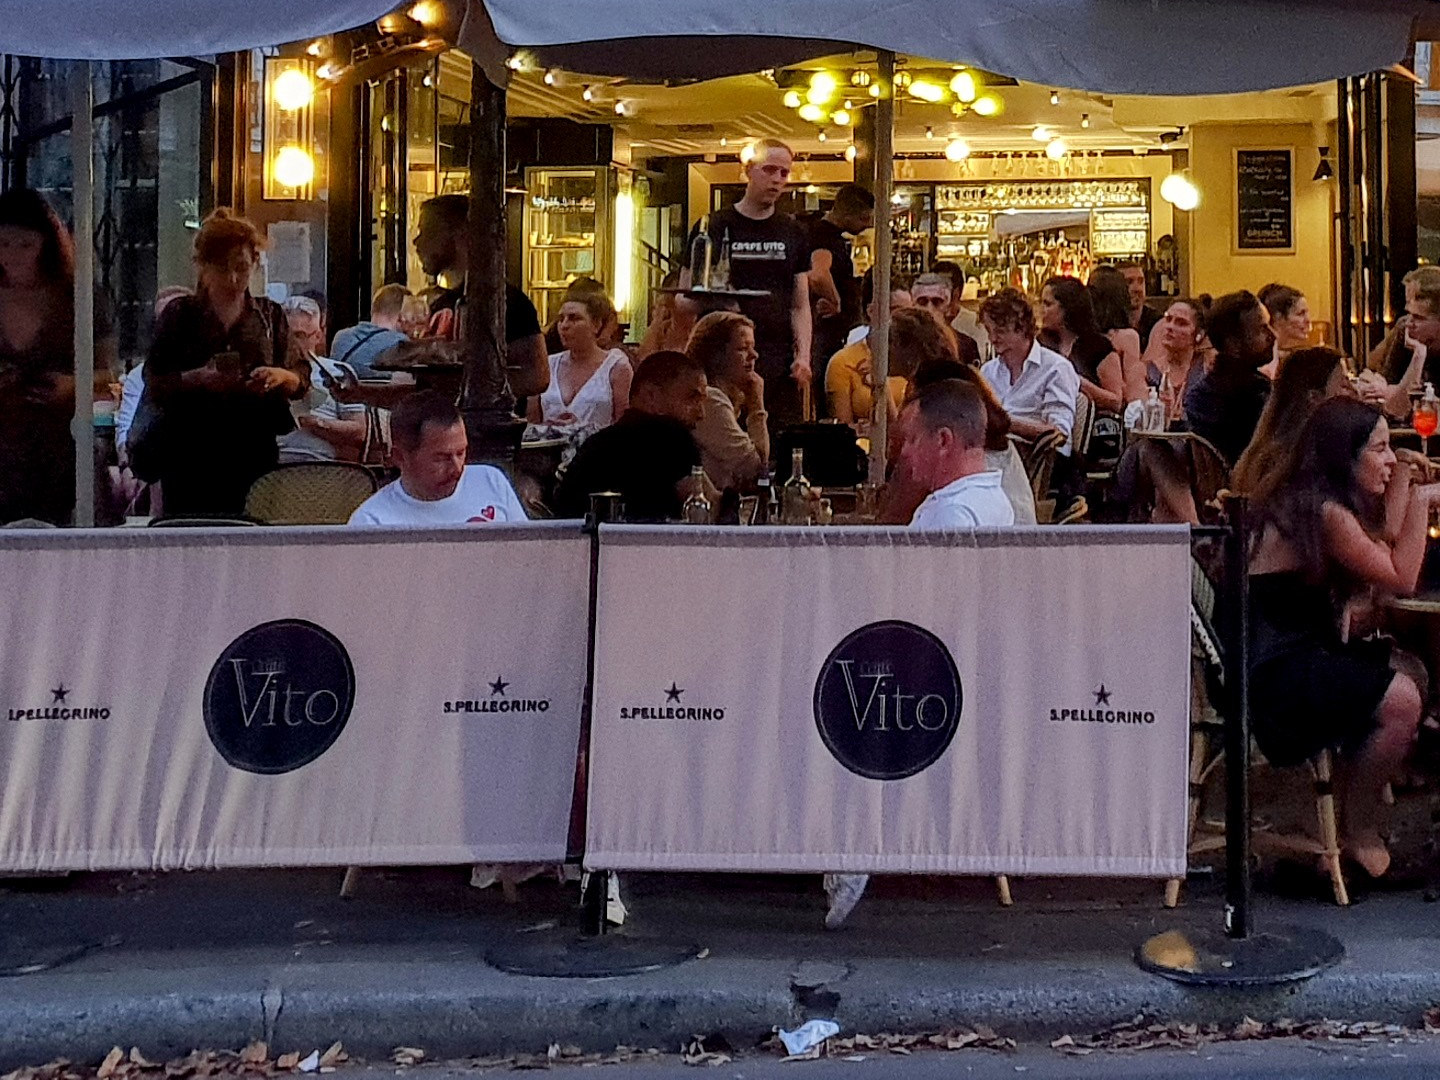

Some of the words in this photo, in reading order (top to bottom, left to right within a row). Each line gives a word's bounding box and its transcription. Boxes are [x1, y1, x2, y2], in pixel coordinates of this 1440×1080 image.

[229, 659, 338, 727] Vito
[836, 660, 947, 731] Vito
[443, 699, 550, 714] S.PELLEGRINO
[620, 707, 724, 720] S.PELLEGRINO
[1050, 709, 1155, 723] S.PELLEGRINO
